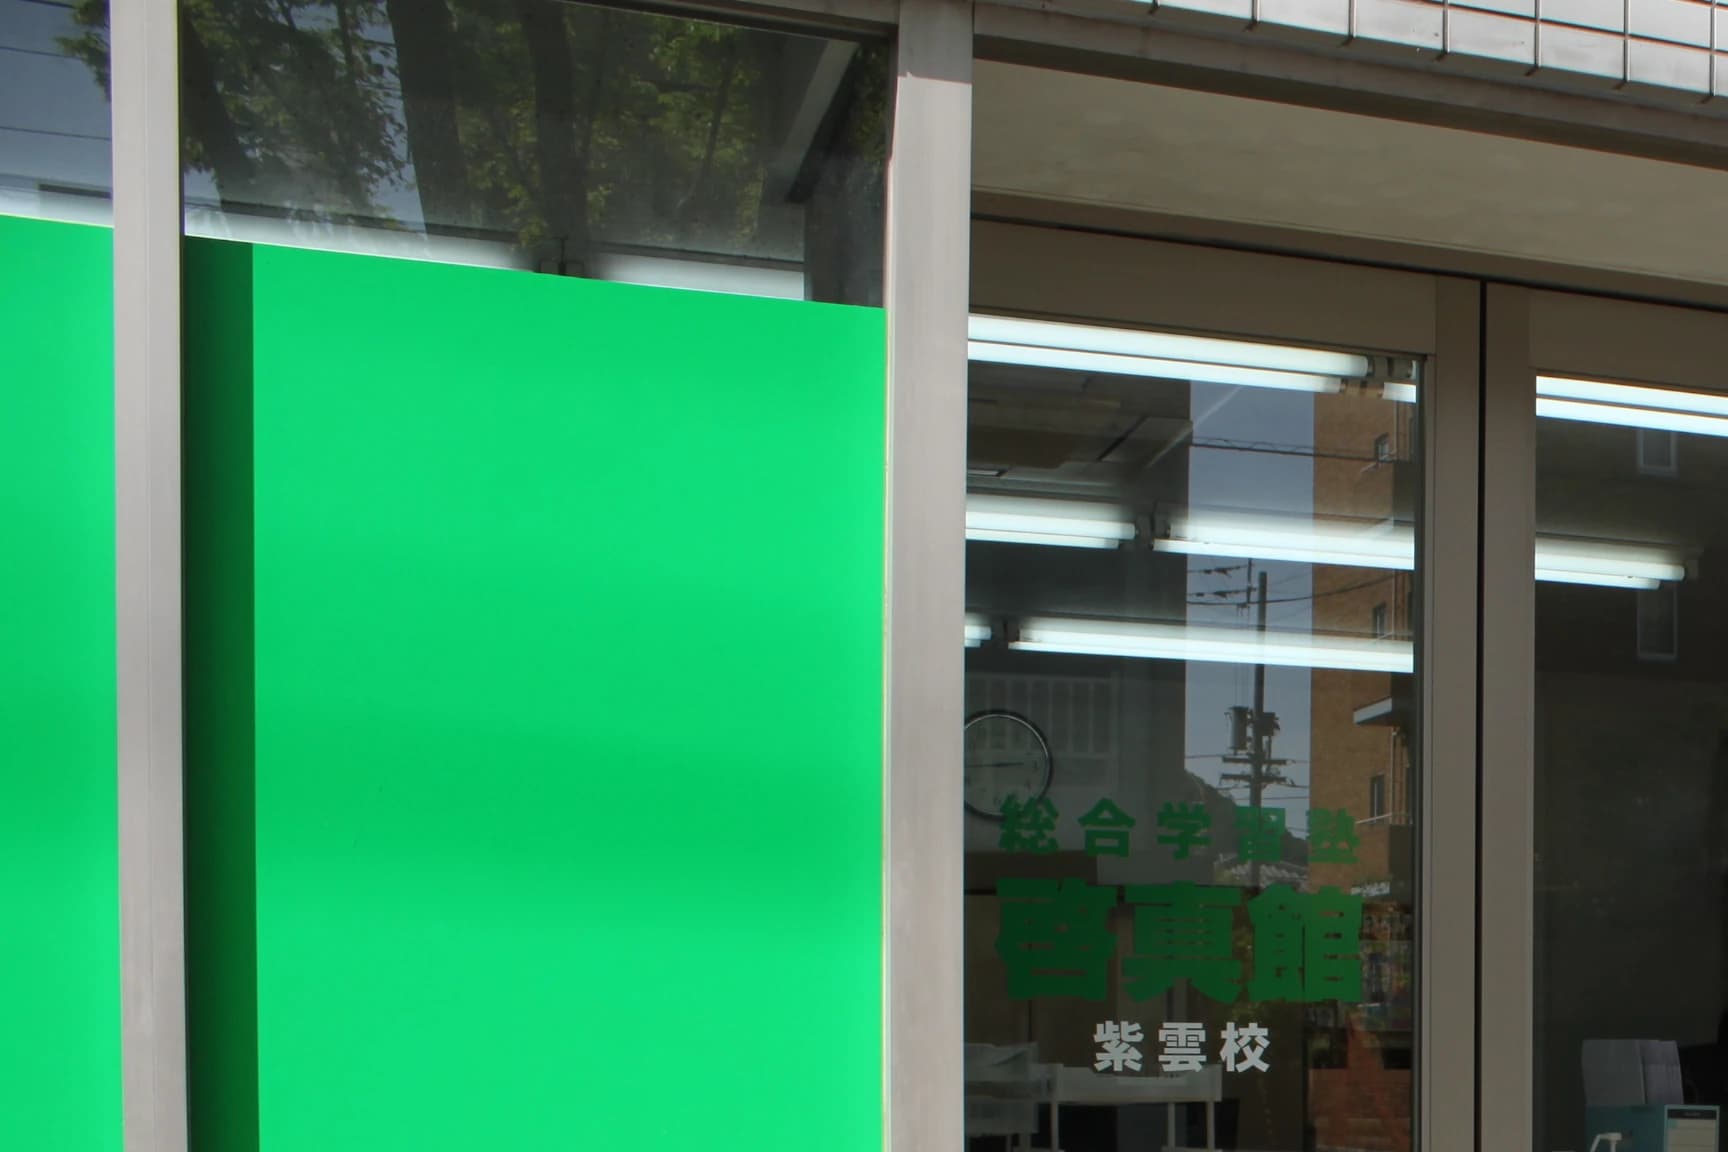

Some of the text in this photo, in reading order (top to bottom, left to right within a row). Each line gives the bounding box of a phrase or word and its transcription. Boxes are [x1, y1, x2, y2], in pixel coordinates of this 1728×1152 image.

[997, 794, 1360, 864] 総合学習塾
[1093, 1021, 1271, 1073] 紫雲校
